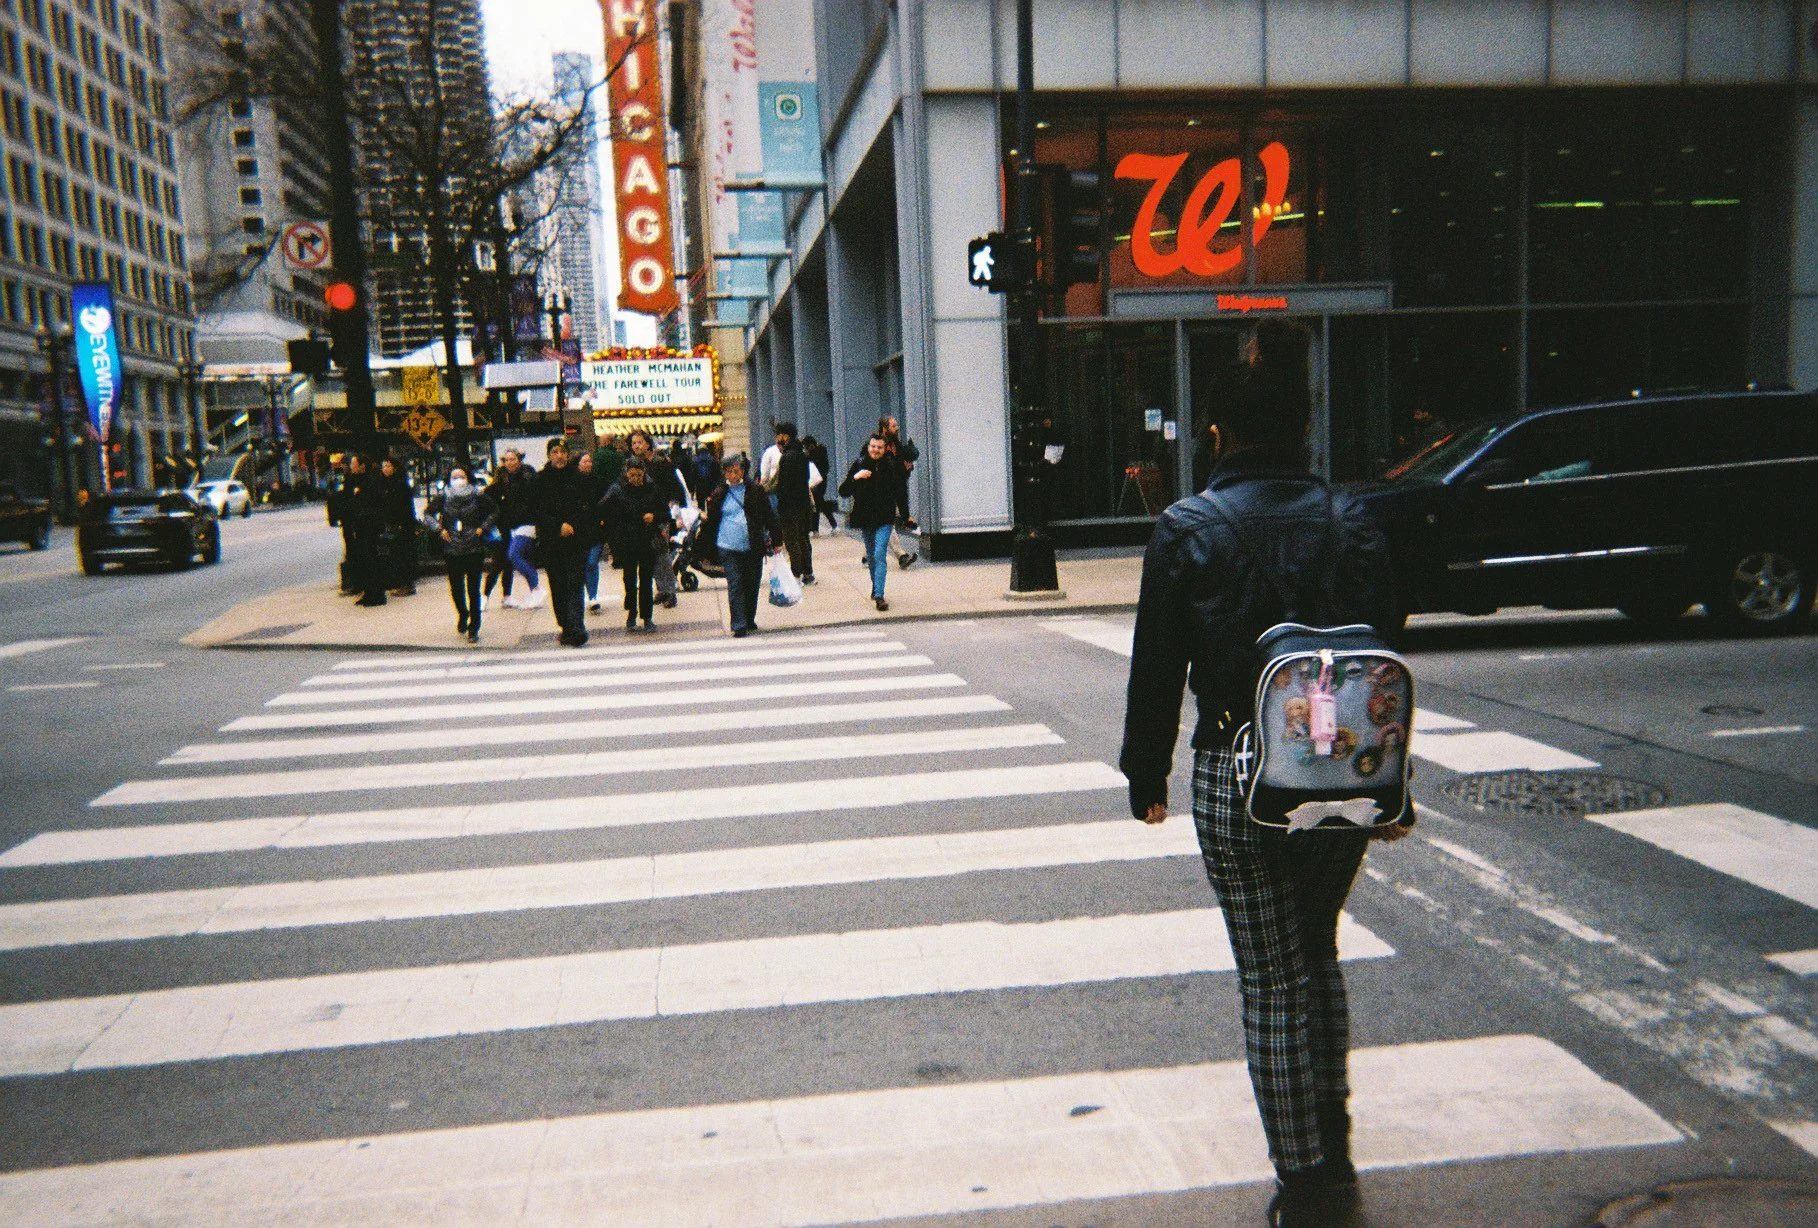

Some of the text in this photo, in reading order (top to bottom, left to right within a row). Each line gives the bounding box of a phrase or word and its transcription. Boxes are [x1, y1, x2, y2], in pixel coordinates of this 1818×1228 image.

[592, 362, 702, 376] HEATHER MCMAHAN
[614, 379, 667, 390] FAREWELL
[675, 377, 701, 388] TOUR
[618, 392, 671, 404] SOLD OUT
